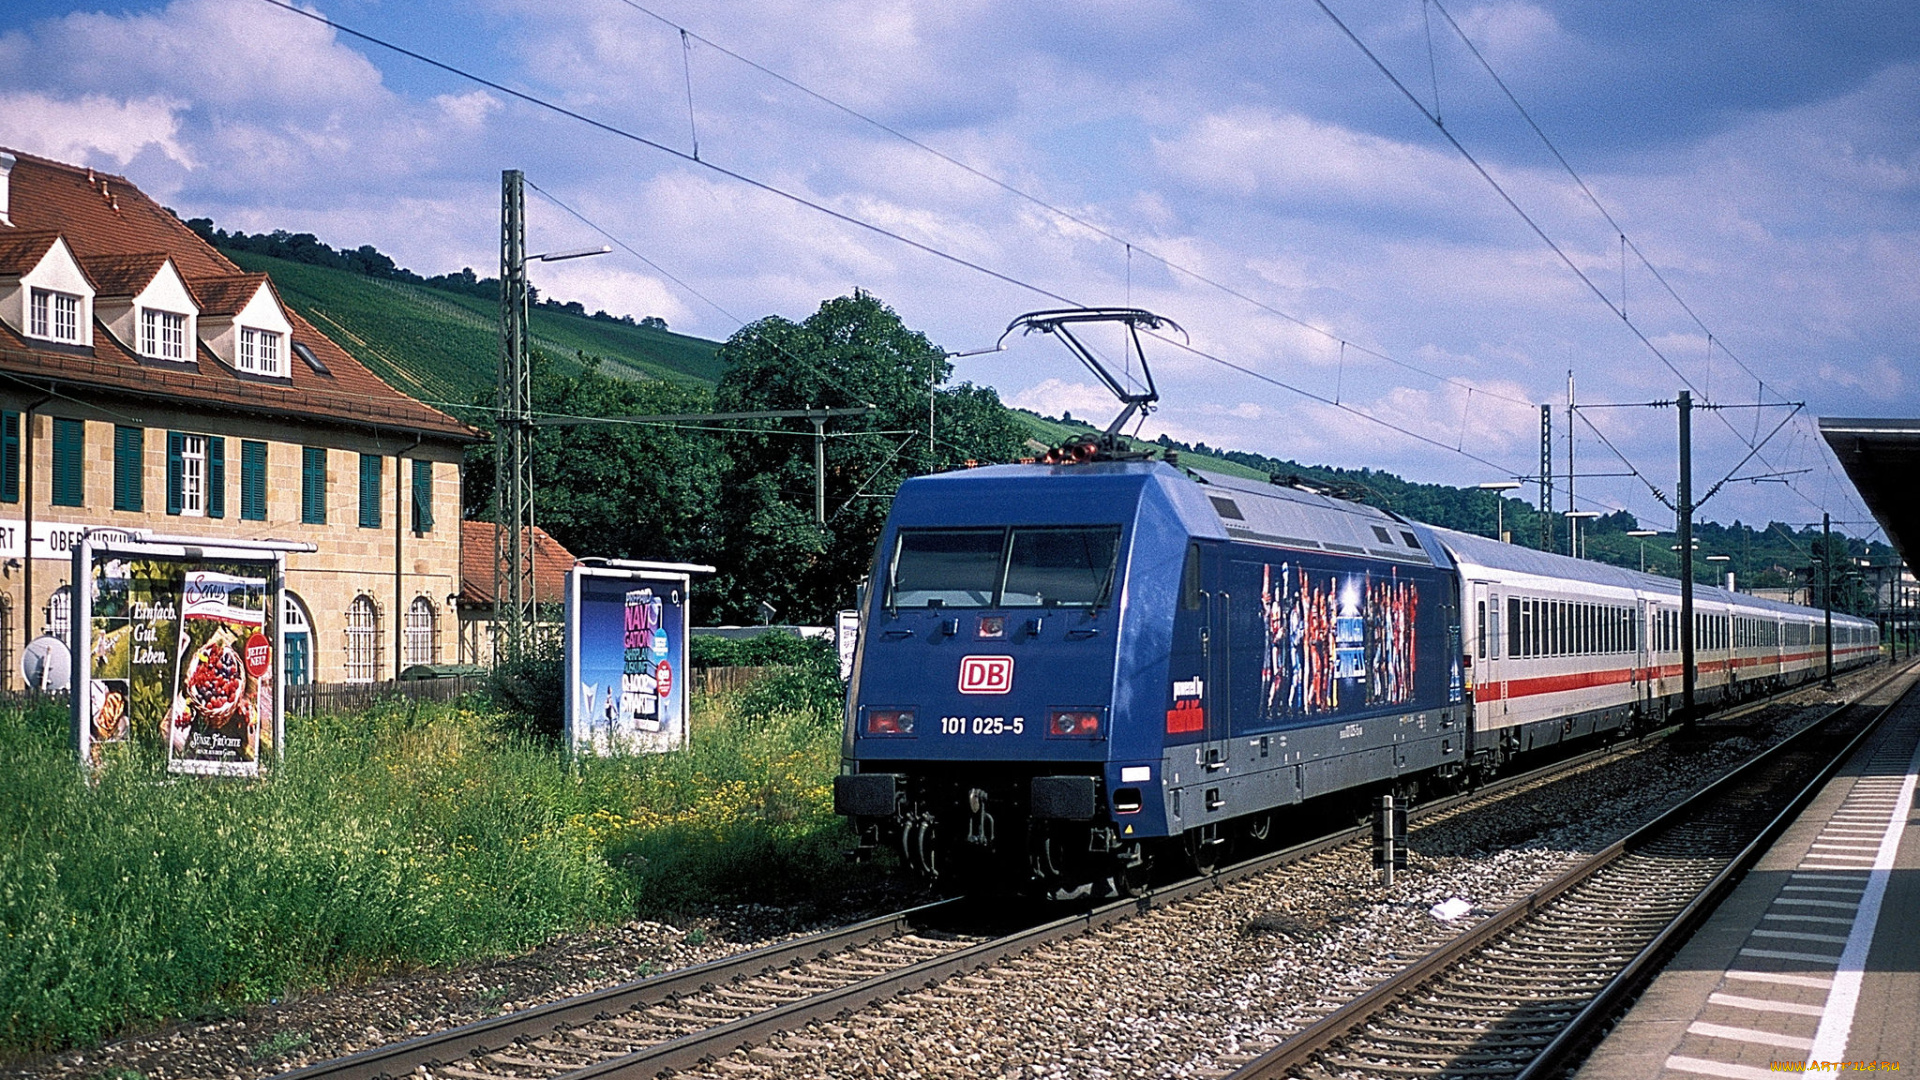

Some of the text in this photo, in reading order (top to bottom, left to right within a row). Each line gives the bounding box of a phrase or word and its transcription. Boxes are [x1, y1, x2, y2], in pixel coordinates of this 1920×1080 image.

[186, 574, 226, 605] Servus
[133, 602, 177, 625] Einfach.
[133, 624, 158, 642] Gut.
[132, 646, 168, 664] Leben.
[246, 645, 269, 660] JETZT
[967, 663, 1005, 686] DB
[941, 717, 1024, 735] 101 025-5
